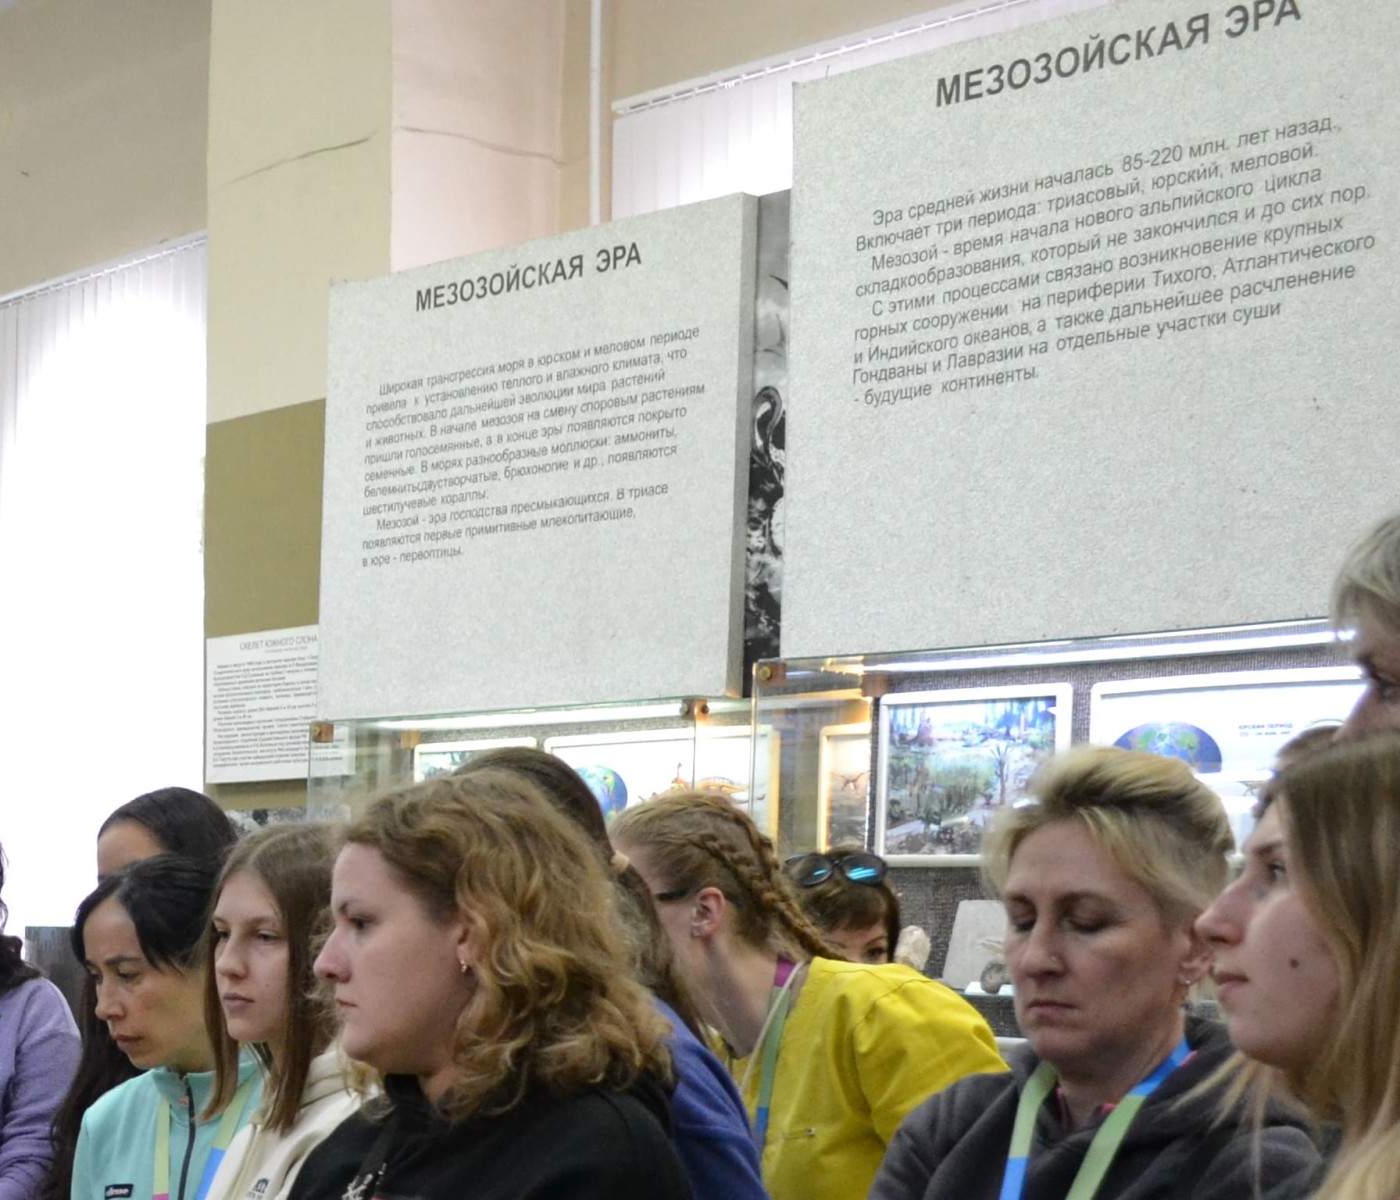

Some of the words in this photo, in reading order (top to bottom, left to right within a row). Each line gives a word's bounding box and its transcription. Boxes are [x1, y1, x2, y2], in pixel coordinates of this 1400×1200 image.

[935, 14, 1210, 107] МЕЗОЗОЙСКАЯ
[1224, 0, 1302, 39] ЭРА
[856, 223, 930, 252] Включает
[936, 218, 962, 236] три
[968, 201, 1041, 231] периода:
[1151, 162, 1224, 191] юрский,
[1230, 142, 1318, 175] меловой.
[872, 209, 903, 227] Эра
[908, 190, 974, 218] средней
[979, 181, 1029, 203] жизни
[1034, 162, 1114, 191] началась
[1122, 145, 1183, 173] 85-220
[1189, 139, 1230, 159] млн.
[1237, 129, 1269, 148] лет
[871, 244, 938, 272] Мезозой
[953, 233, 1003, 257] время
[1010, 219, 1069, 244] начала
[1075, 206, 1133, 230] нового
[1139, 181, 1254, 217] альпийского
[1264, 167, 1322, 193] цикла
[1031, 232, 1101, 263] который
[1107, 231, 1127, 248] не
[1133, 208, 1238, 242] закончился
[1245, 207, 1255, 220] и
[1261, 201, 1285, 222] до
[1292, 192, 1323, 212] сих
[1330, 184, 1371, 206] пор.
[415, 254, 584, 312] МЕЗОЗОЙСКАЯ
[595, 242, 642, 273] ЭРА
[854, 320, 907, 342] горных
[1022, 296, 1041, 312] на
[1046, 277, 1146, 308] периферии
[1222, 235, 1375, 276] Атлантического
[872, 300, 883, 317] С
[888, 295, 935, 314] этими
[942, 271, 1040, 306] процессами
[1045, 258, 1113, 284] связано
[1119, 232, 1257, 270] возникновение
[1263, 216, 1344, 246] крупных
[853, 359, 927, 385] Гондваны
[933, 359, 941, 372] и
[946, 343, 1024, 370] Лавразии
[1029, 341, 1048, 356] на
[1056, 323, 1151, 351] отдельные
[1156, 310, 1227, 340] участки
[1232, 302, 1281, 327] суши
[854, 352, 863, 364] и
[868, 333, 958, 364] Индийского
[963, 321, 1032, 347] океанов,
[1037, 319, 1046, 333] а
[1055, 307, 1104, 330] также
[1109, 287, 1224, 323] дальнейшее
[1230, 263, 1356, 305] расчленение
[366, 398, 407, 416] привела
[414, 396, 419, 406] к
[425, 382, 498, 407] установлению
[501, 374, 543, 391] теплого
[546, 374, 552, 383] и
[556, 363, 609, 381] влажного
[612, 353, 664, 371] климата,
[667, 348, 687, 360] что
[379, 378, 423, 396] Широкая
[427, 365, 495, 388] трансгрессия
[498, 358, 525, 375] моря
[528, 358, 534, 368] в
[537, 349, 580, 366] юрском
[584, 349, 590, 358] и
[594, 337, 645, 356] меловом
[650, 327, 700, 346] периоде
[864, 381, 932, 407] будущие
[941, 364, 1039, 395] континенты.
[365, 439, 371, 448] и
[430, 425, 437, 437] В
[440, 420, 477, 435] начале
[481, 412, 524, 428] мезозоя
[527, 410, 540, 422] на
[543, 403, 578, 419] смену
[580, 394, 638, 413] споровым
[641, 384, 705, 405] растениям
[366, 408, 448, 431] способствовало
[450, 395, 516, 418] дальнейшей
[518, 386, 574, 405] эволюции
[577, 380, 606, 396] мира
[611, 369, 665, 390] растений
[364, 451, 403, 465] пришли
[486, 436, 492, 446] а
[496, 434, 503, 444] в
[506, 428, 538, 443] конце
[541, 425, 562, 439] эры
[567, 413, 635, 433] появляются
[421, 461, 428, 473] В
[431, 460, 462, 473] морях
[466, 447, 548, 469] разнообразные
[504, 460, 569, 479] брюхоногие
[574, 459, 580, 468] и
[608, 444, 677, 464] появляются
[362, 533, 421, 550] появляются
[424, 529, 462, 544] первые
[465, 519, 537, 538] примитивные
[363, 496, 436, 516] шестилучевые
[377, 514, 419, 531] Мезозой
[429, 513, 446, 525] эра
[450, 504, 507, 521] господства
[616, 487, 624, 500] В
[629, 483, 668, 500] триасе
[362, 557, 367, 567] в
[370, 554, 391, 569] юре
